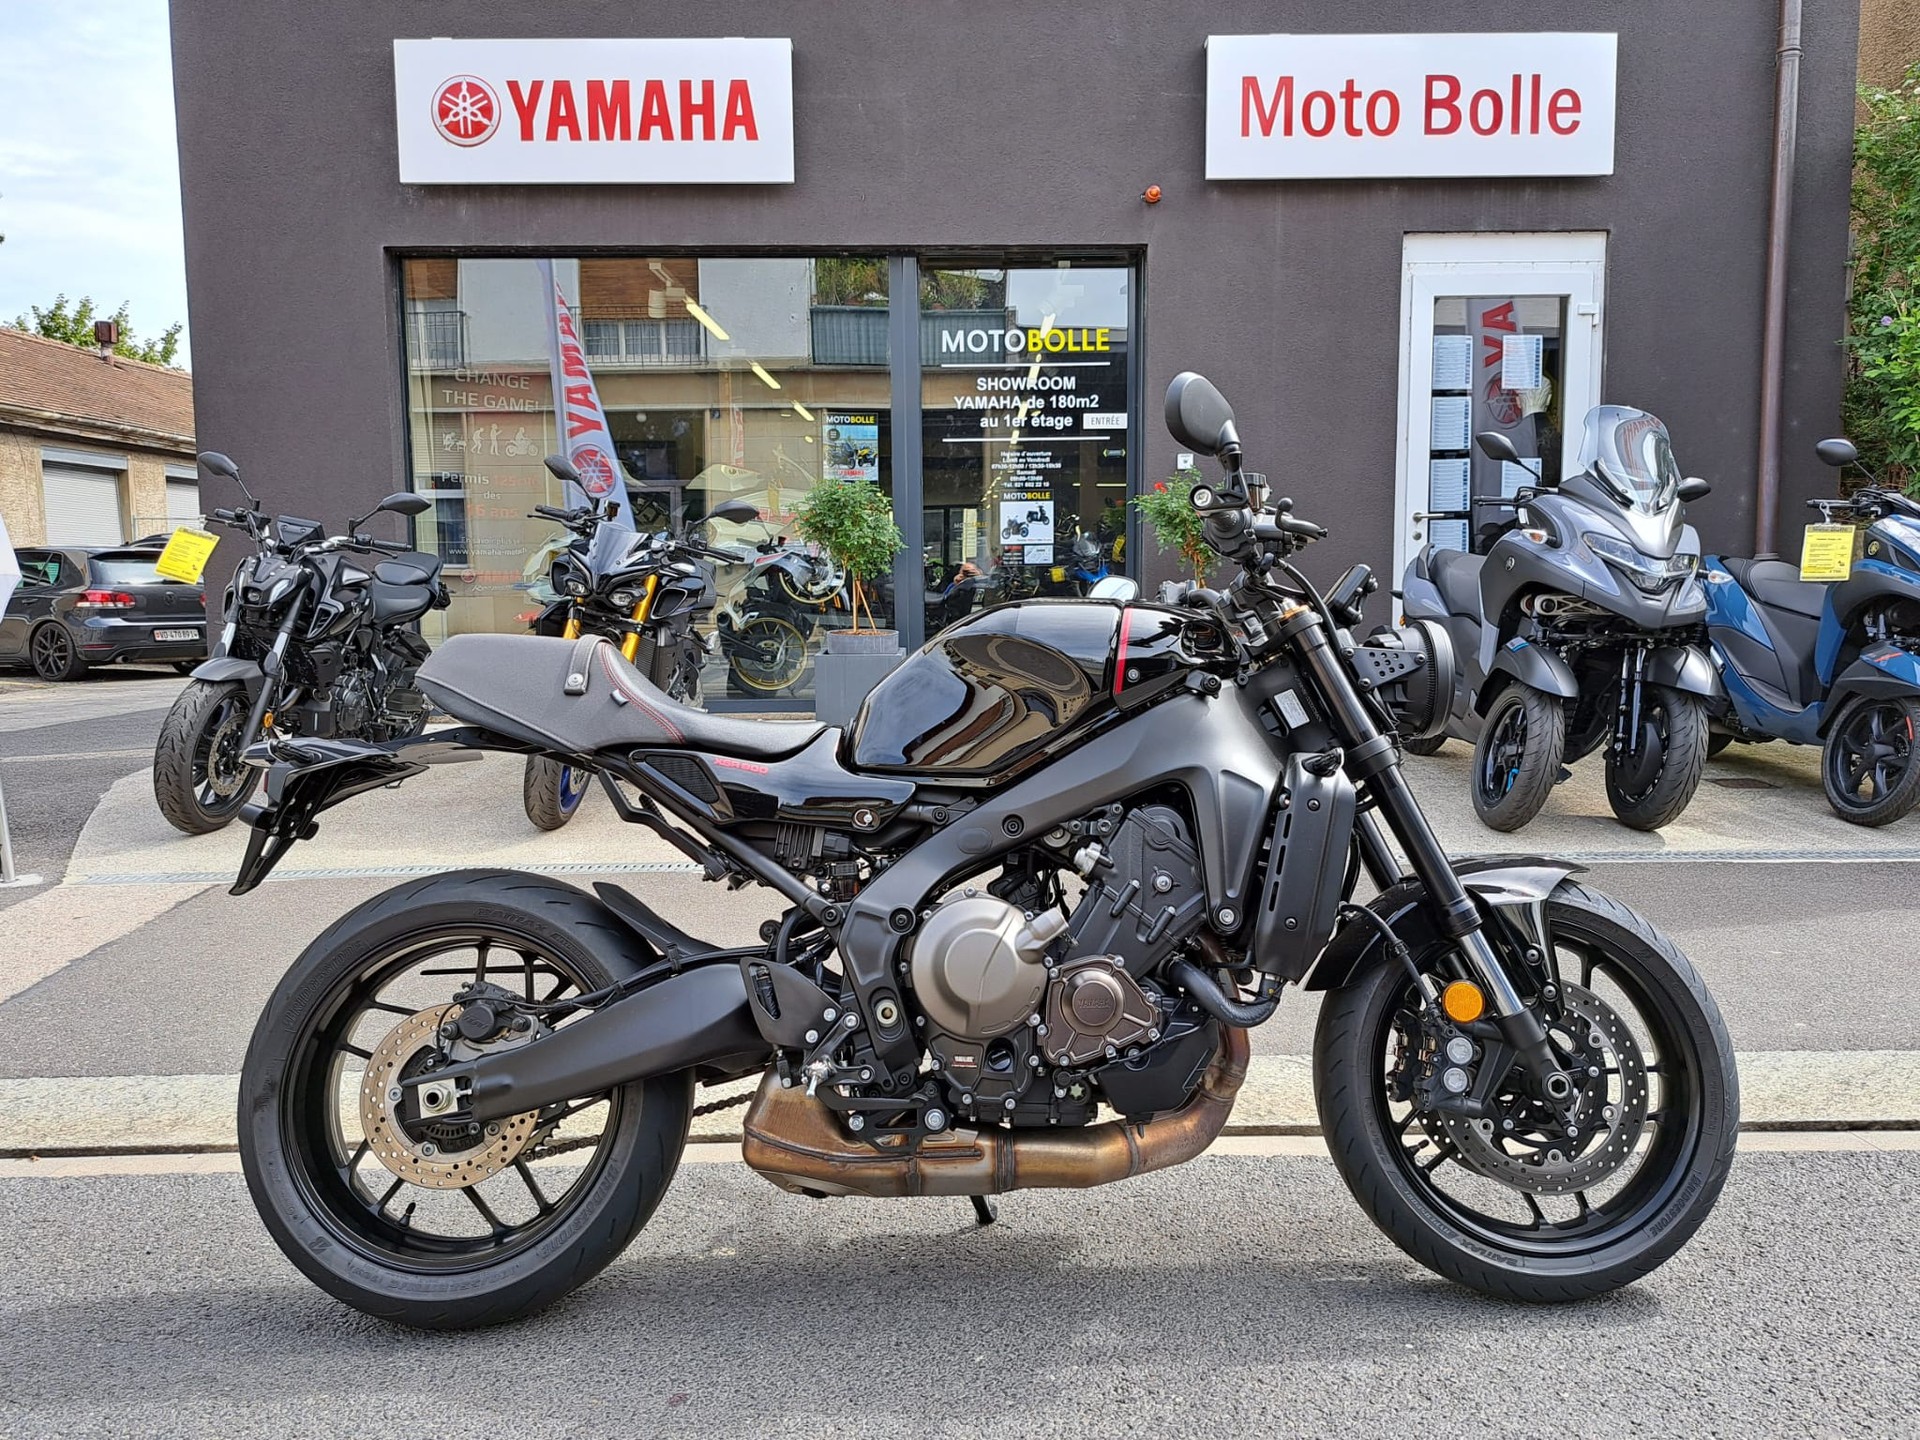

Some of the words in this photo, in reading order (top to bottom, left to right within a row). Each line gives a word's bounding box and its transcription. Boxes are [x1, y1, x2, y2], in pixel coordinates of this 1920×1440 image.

[506, 80, 759, 141] YAMAHA
[1240, 75, 1400, 138] Moto
[1423, 73, 1582, 136] Bolle
[941, 328, 1110, 353] MOTOBOLLE
[454, 368, 530, 390] CHANGE
[976, 376, 1077, 391] SHOWROOM
[442, 389, 478, 407] THE
[483, 394, 540, 413] GAME!
[954, 396, 1021, 410] YAMAHA
[1027, 396, 1045, 408] de
[1050, 394, 1100, 409] 180m2
[826, 416, 875, 424] MOTOBOLLE
[980, 418, 999, 428] au
[1003, 414, 1027, 428] 1er
[1090, 415, 1122, 427] ENTRÉE
[442, 471, 490, 485] Permis
